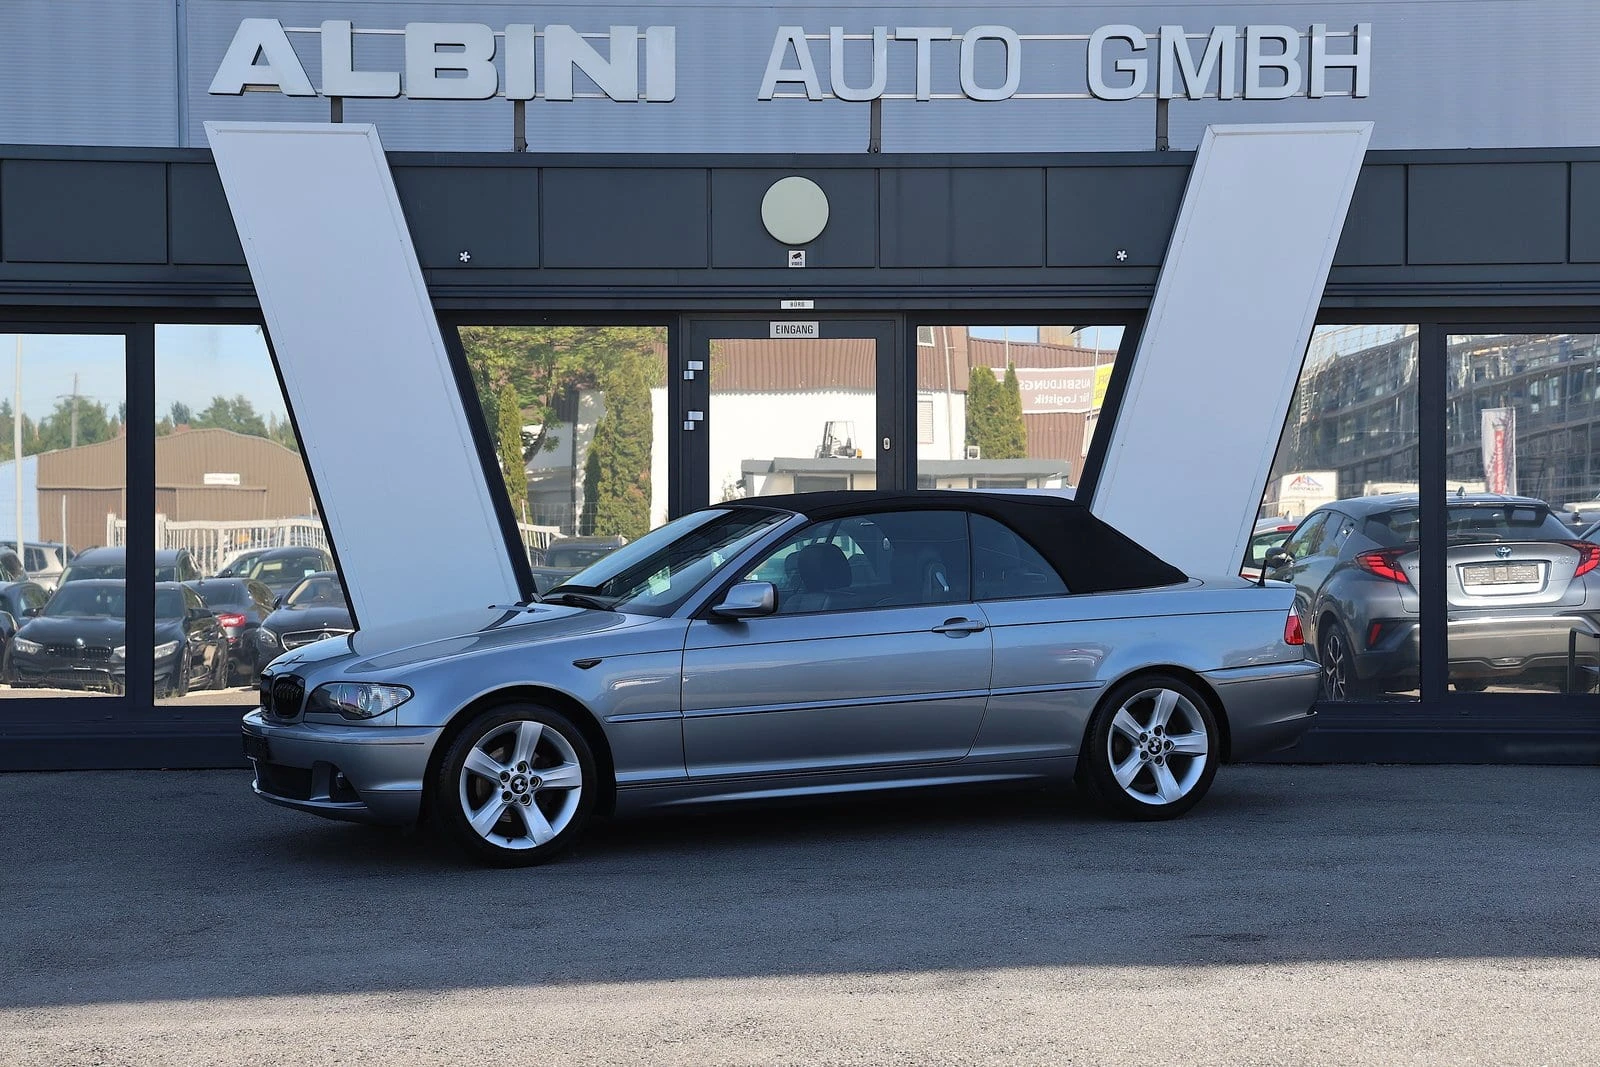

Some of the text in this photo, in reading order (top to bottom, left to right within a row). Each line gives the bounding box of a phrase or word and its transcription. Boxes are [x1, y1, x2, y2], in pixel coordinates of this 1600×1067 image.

[208, 18, 1372, 102] ALBINI AUTO GMBH
[775, 324, 814, 335] EINGANG
